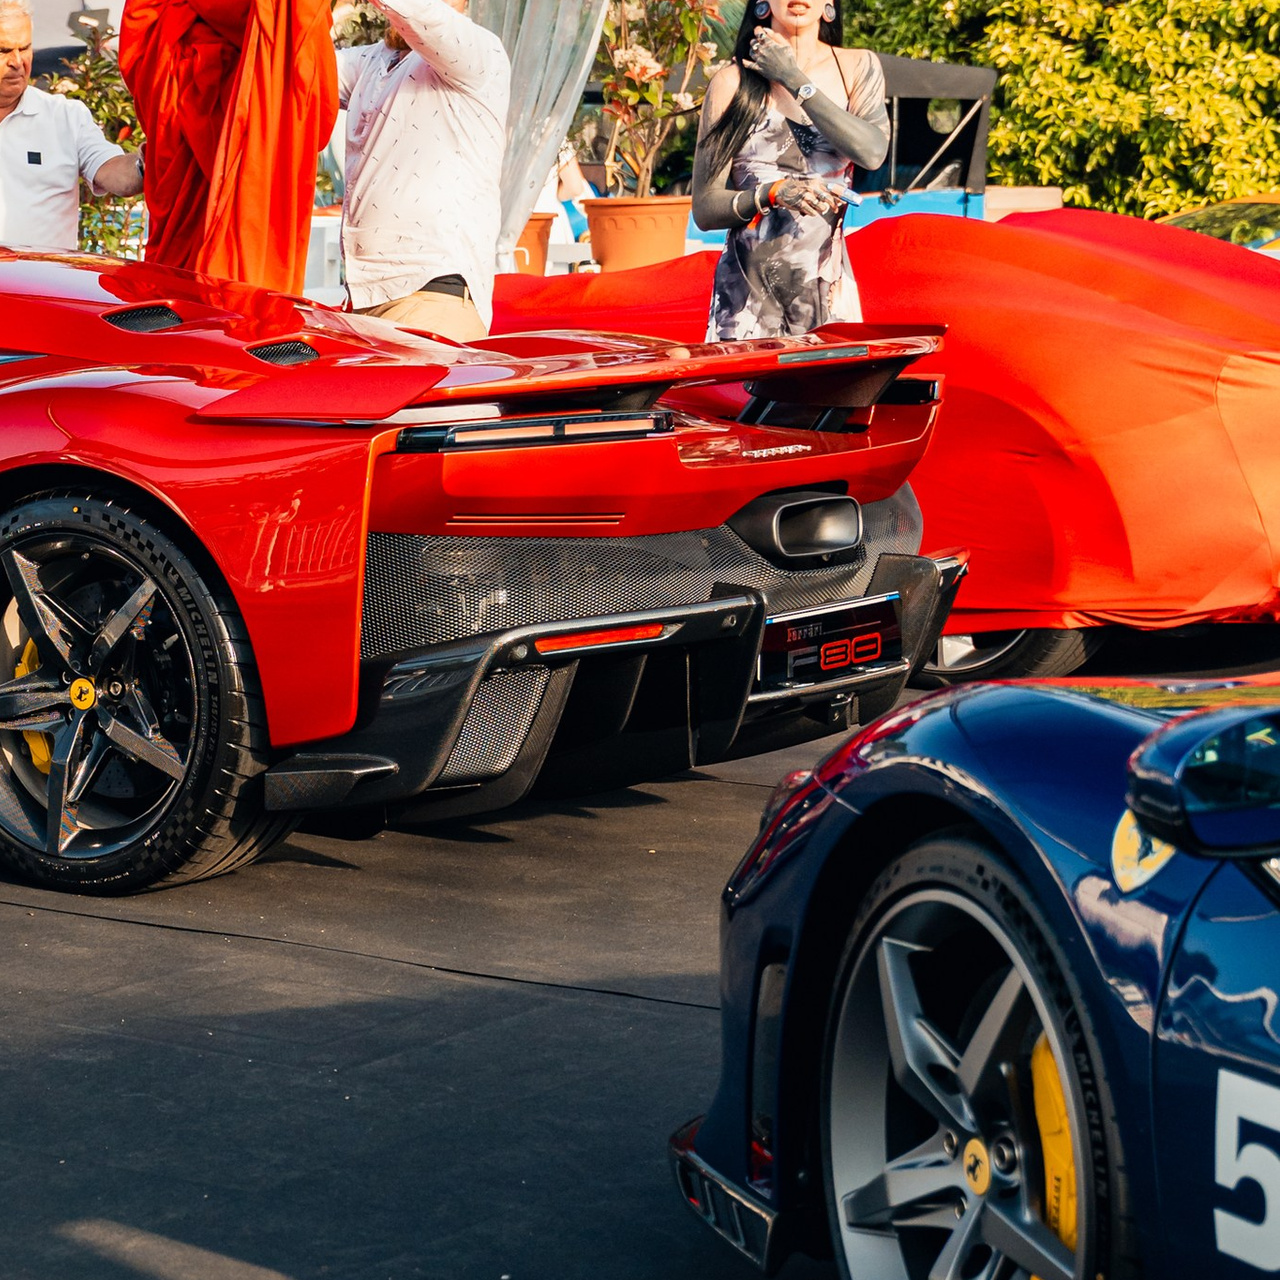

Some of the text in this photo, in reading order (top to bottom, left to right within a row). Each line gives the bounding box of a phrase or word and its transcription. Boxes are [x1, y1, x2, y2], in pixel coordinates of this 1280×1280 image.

[177, 586, 218, 684] MICHELIN
[787, 621, 822, 642] Ferrari
[787, 632, 881, 678] F80
[1075, 1052, 1109, 1198] MICHELIN
